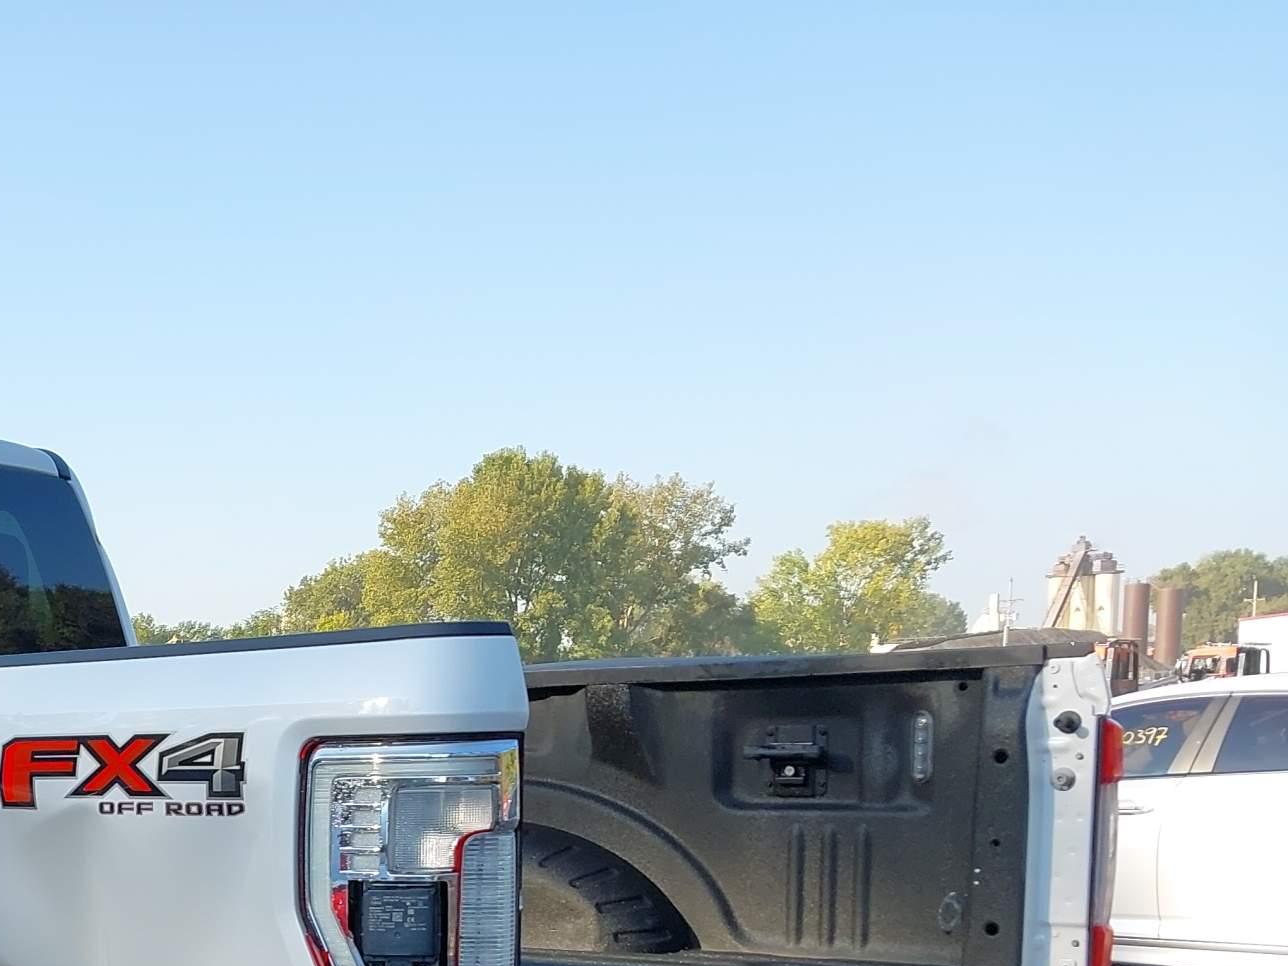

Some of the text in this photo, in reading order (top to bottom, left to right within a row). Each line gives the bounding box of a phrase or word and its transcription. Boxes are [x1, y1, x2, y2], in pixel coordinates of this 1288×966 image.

[1122, 726, 1168, 746] 0397
[0, 732, 245, 809] FX4
[98, 801, 245, 816] OFF ROAD
